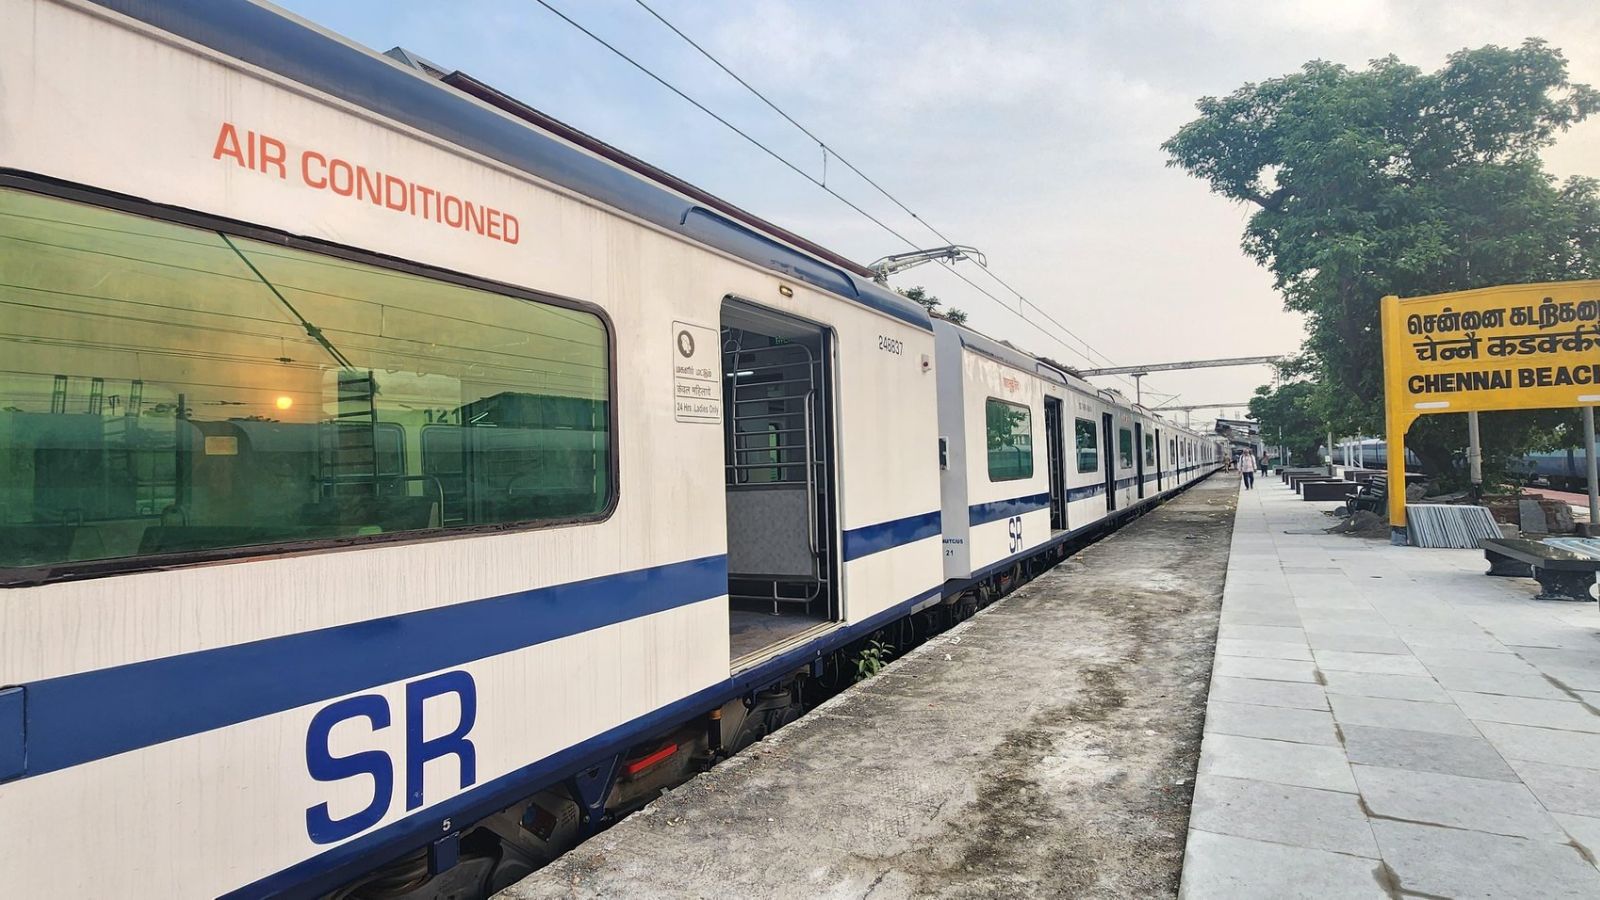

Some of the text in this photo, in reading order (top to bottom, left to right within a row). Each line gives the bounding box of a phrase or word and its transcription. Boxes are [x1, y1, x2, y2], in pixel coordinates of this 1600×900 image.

[213, 122, 520, 245] AIR CONDITIONED
[1407, 307, 1506, 334] சென்னை
[1408, 369, 1512, 394] CHENNAI
[709, 404, 718, 416] Only
[1009, 515, 1023, 554] SR
[305, 669, 477, 845] SR
[442, 817, 451, 831] 5
